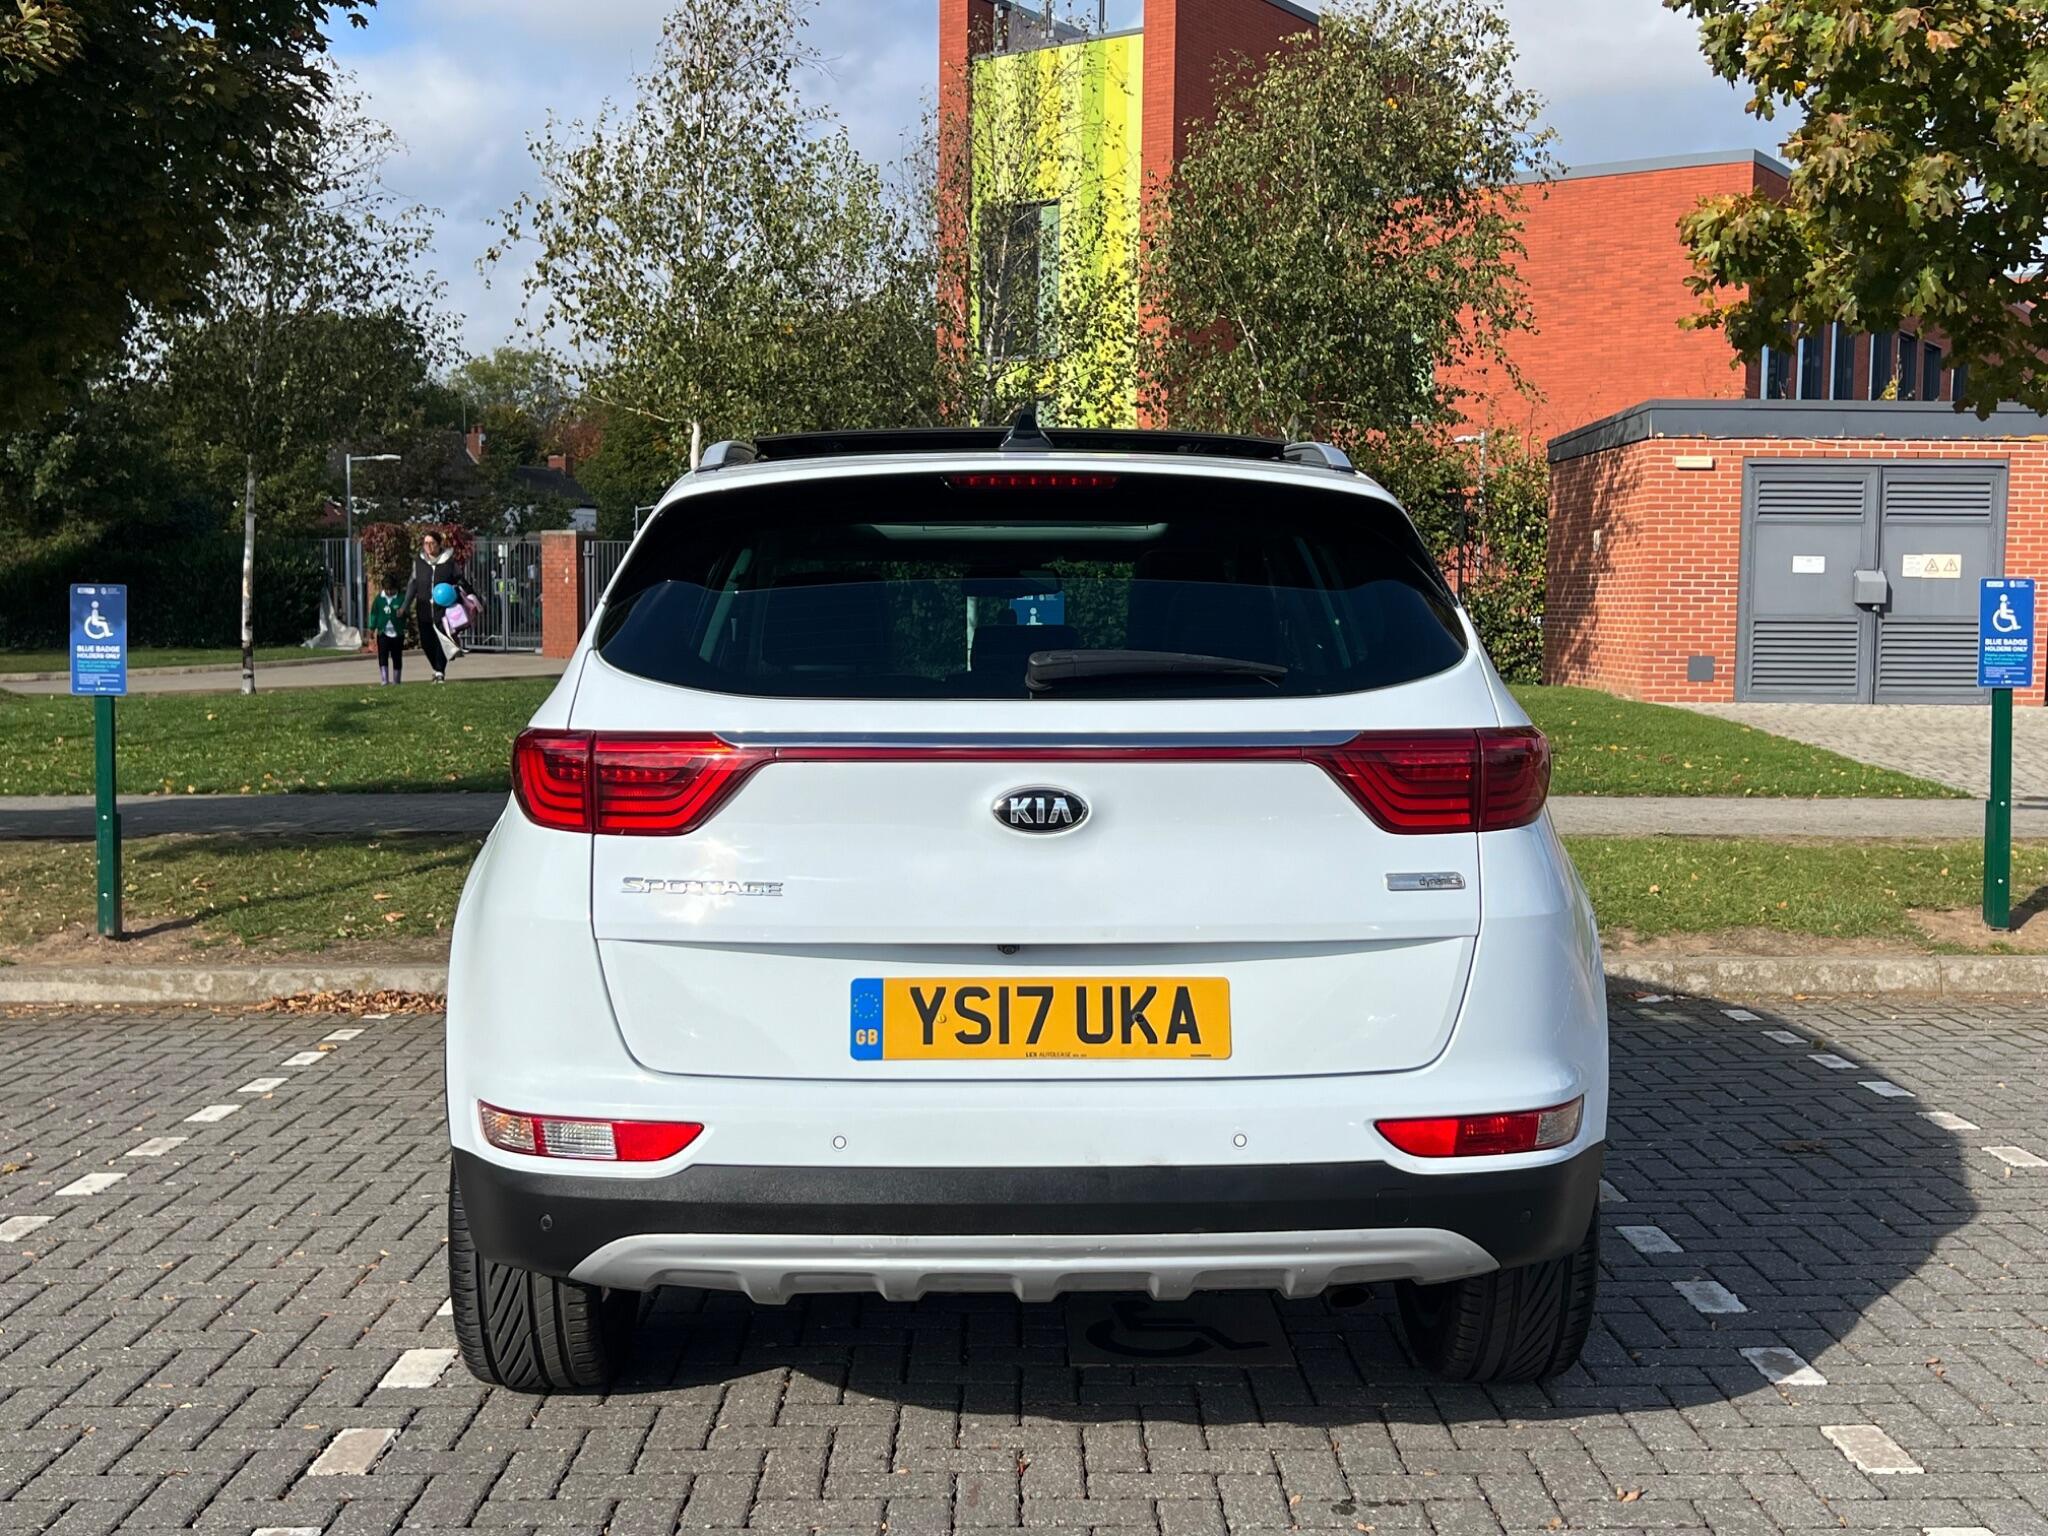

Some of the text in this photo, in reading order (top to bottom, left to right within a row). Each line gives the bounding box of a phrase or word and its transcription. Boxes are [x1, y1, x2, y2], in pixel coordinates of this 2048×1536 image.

[95, 645, 120, 653] BADGE
[1009, 797, 1073, 824] KIA
[910, 986, 1202, 1045] YS17 UKA
[856, 1028, 878, 1045] GB
